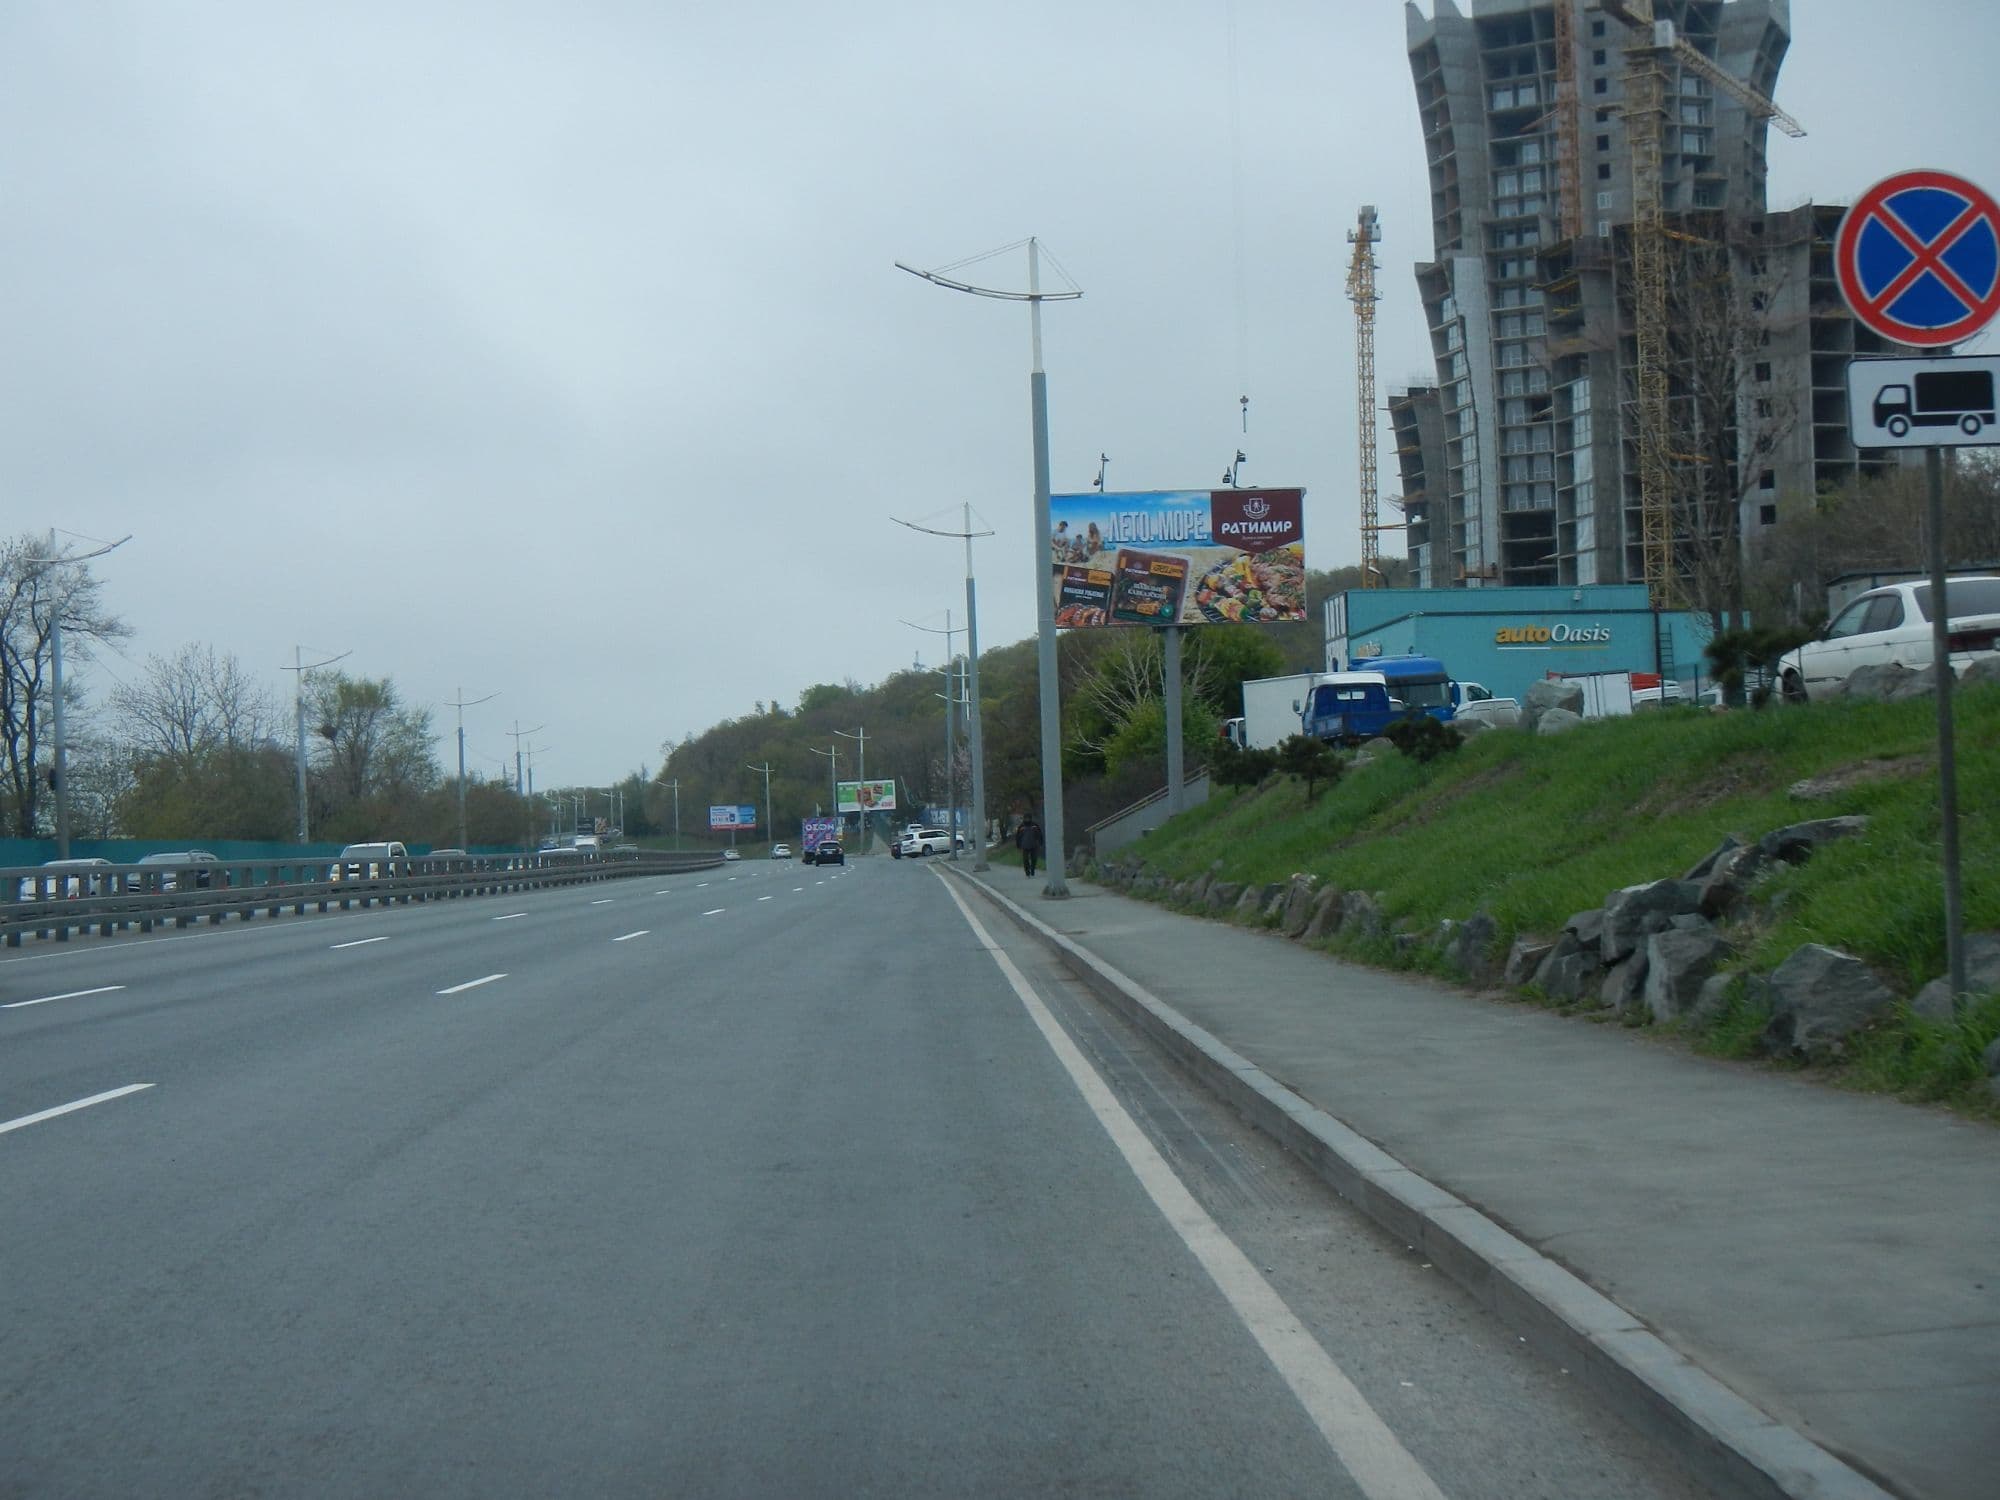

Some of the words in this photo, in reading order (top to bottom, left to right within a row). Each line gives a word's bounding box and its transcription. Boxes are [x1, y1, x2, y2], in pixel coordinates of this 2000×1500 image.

[1108, 511, 1154, 543] ЛЕТО.
[1158, 510, 1207, 541] МОРЕ.
[1221, 521, 1292, 534] РАТИМИР
[1496, 623, 1610, 642] autoOasis
[805, 823, 836, 832] OZON
